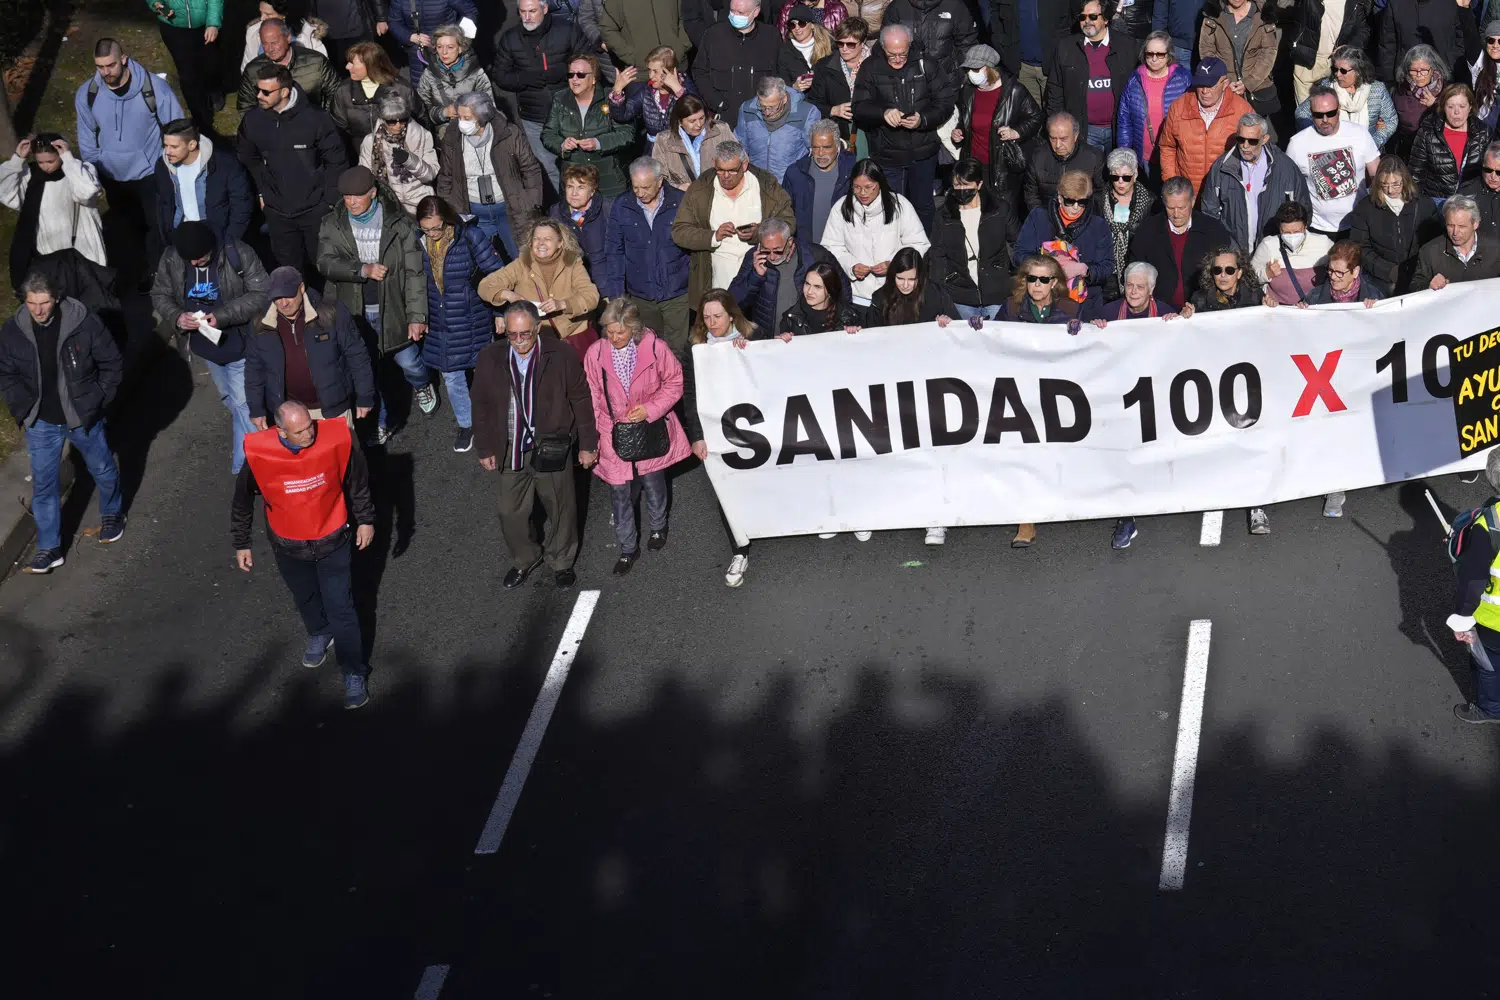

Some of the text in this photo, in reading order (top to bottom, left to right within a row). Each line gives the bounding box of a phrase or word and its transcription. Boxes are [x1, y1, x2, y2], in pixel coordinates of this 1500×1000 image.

[192, 282, 213, 293] NIKE
[208, 292, 218, 301] SB
[1453, 340, 1474, 362] TU
[719, 376, 1093, 470] SANIDAD
[1122, 360, 1264, 444] 100
[1291, 348, 1347, 418] X
